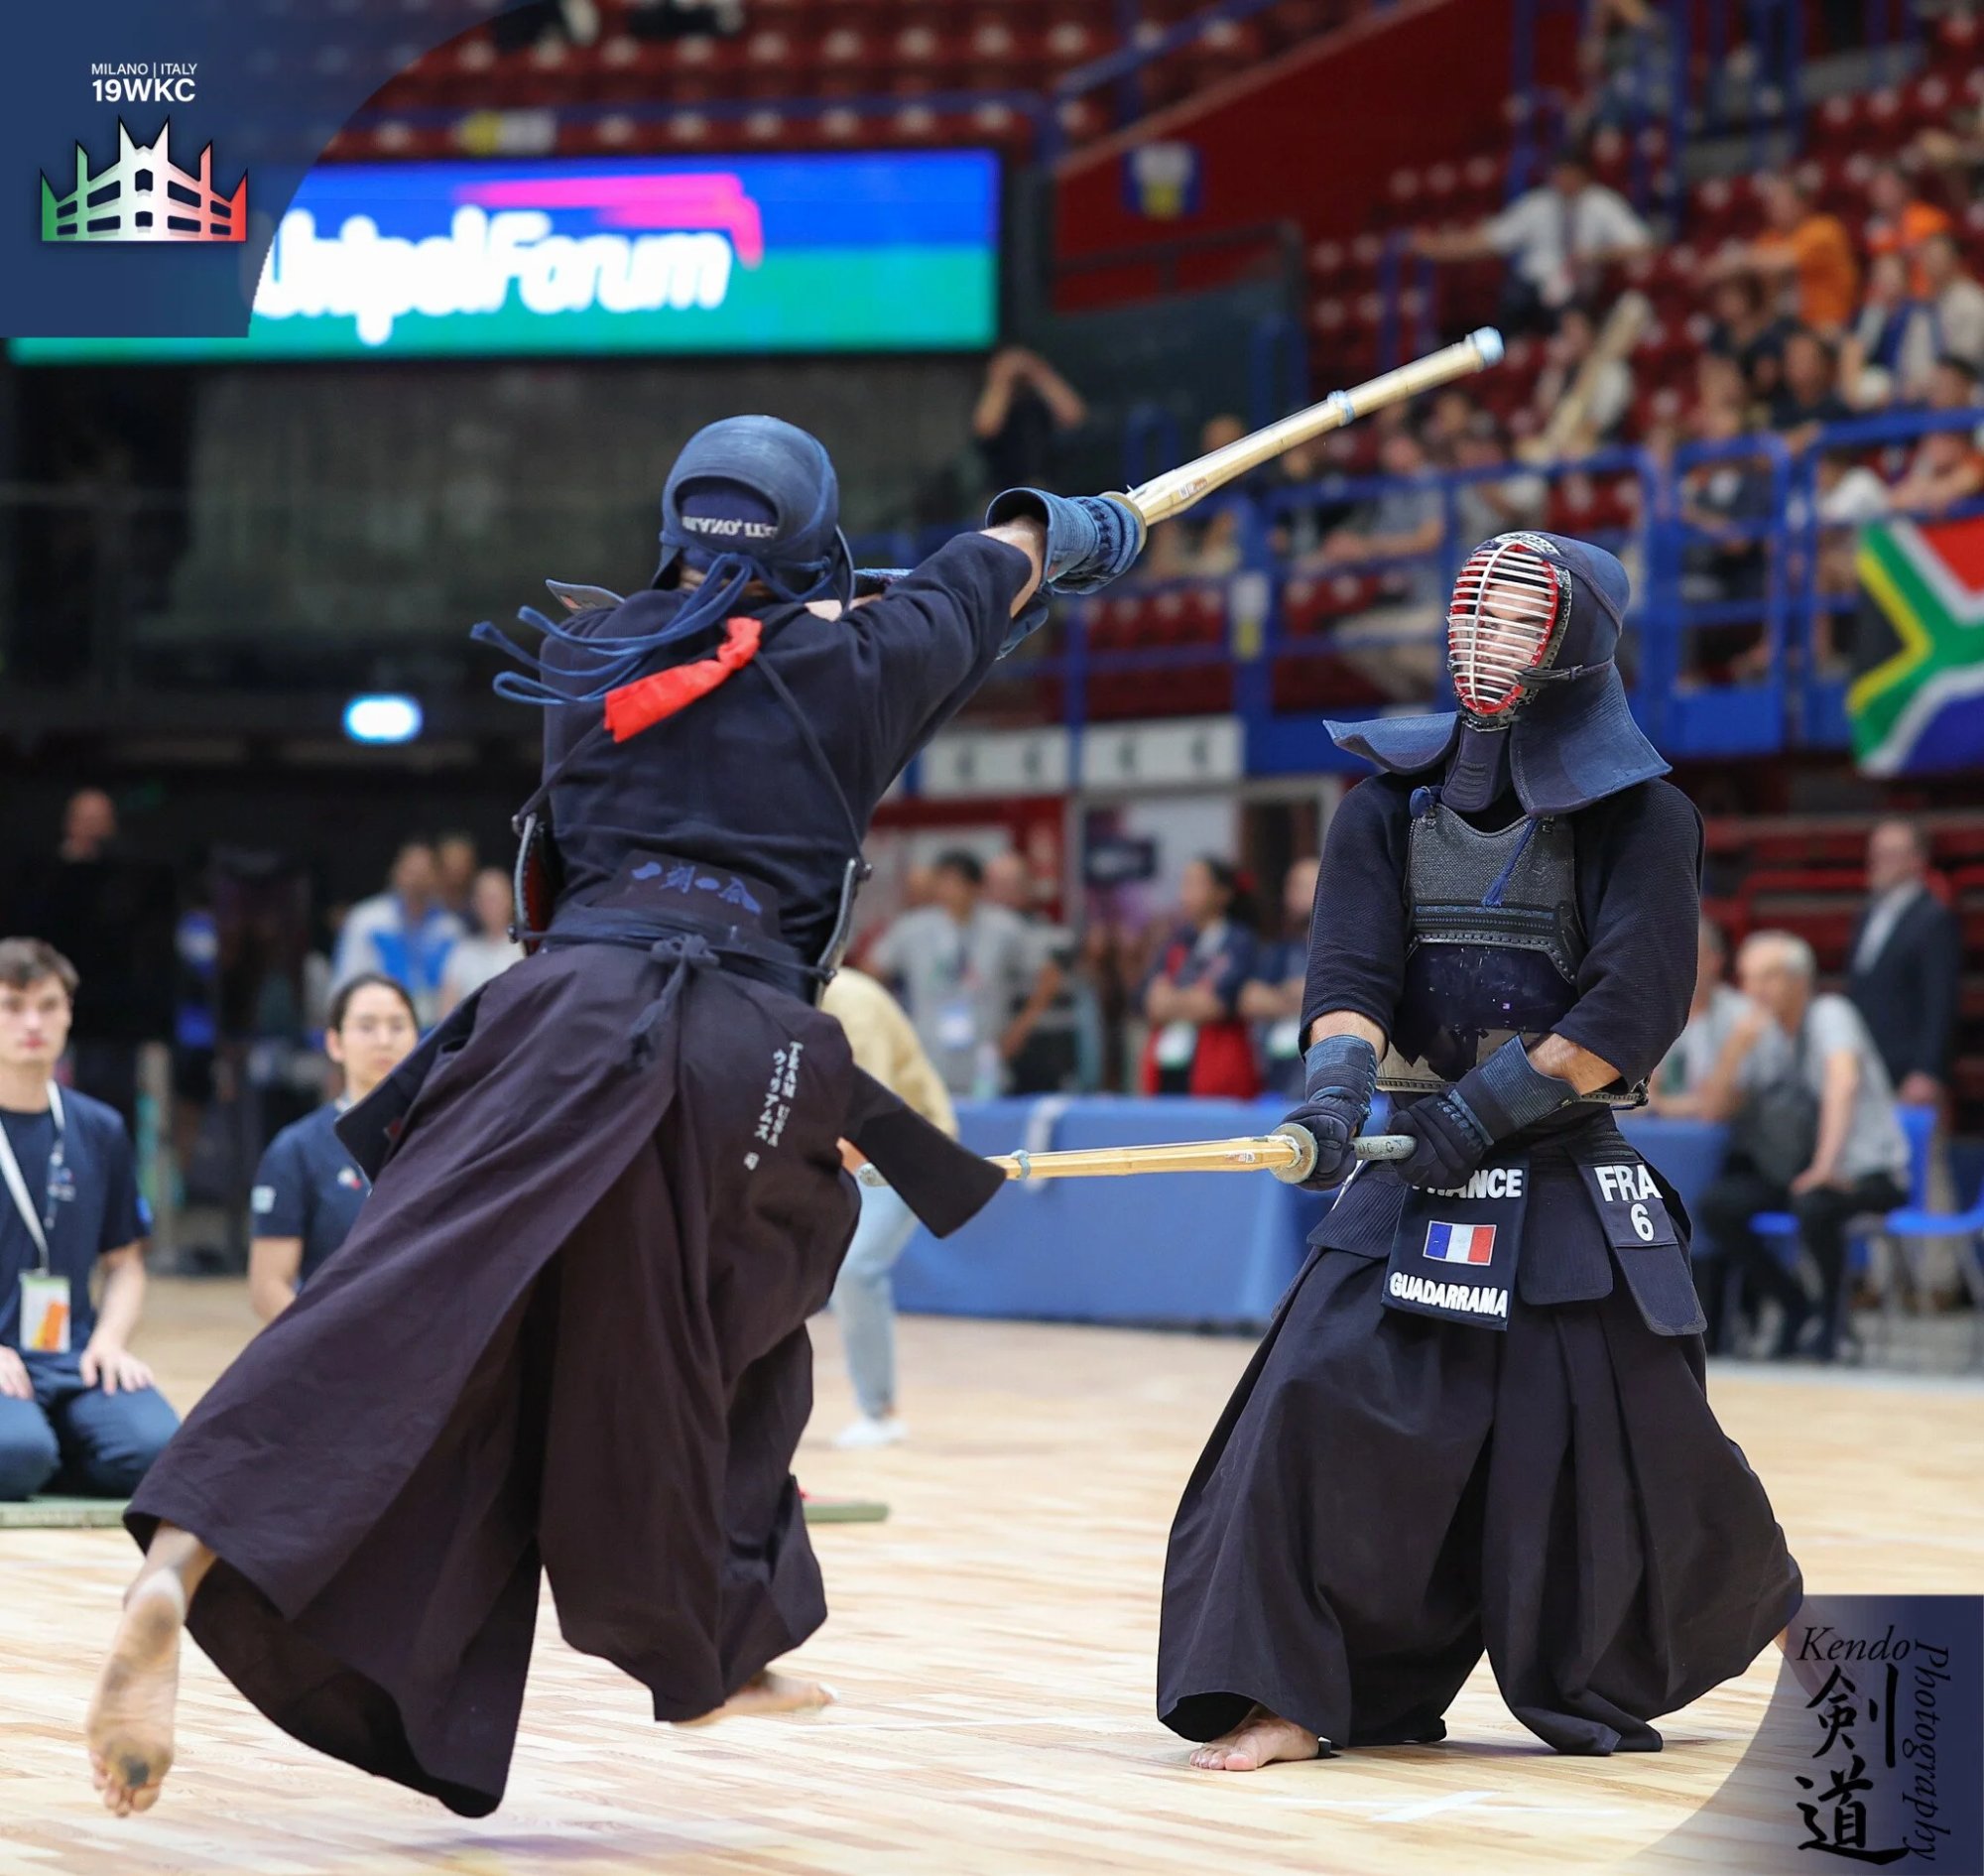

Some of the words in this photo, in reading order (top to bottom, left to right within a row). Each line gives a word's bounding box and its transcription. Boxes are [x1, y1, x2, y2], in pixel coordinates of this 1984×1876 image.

[1412, 1168, 1523, 1199] NCE
[1593, 1164, 1664, 1204] FRA
[1630, 1202, 1655, 1242] 6
[1389, 1271, 1509, 1318] GUADARRAMA
